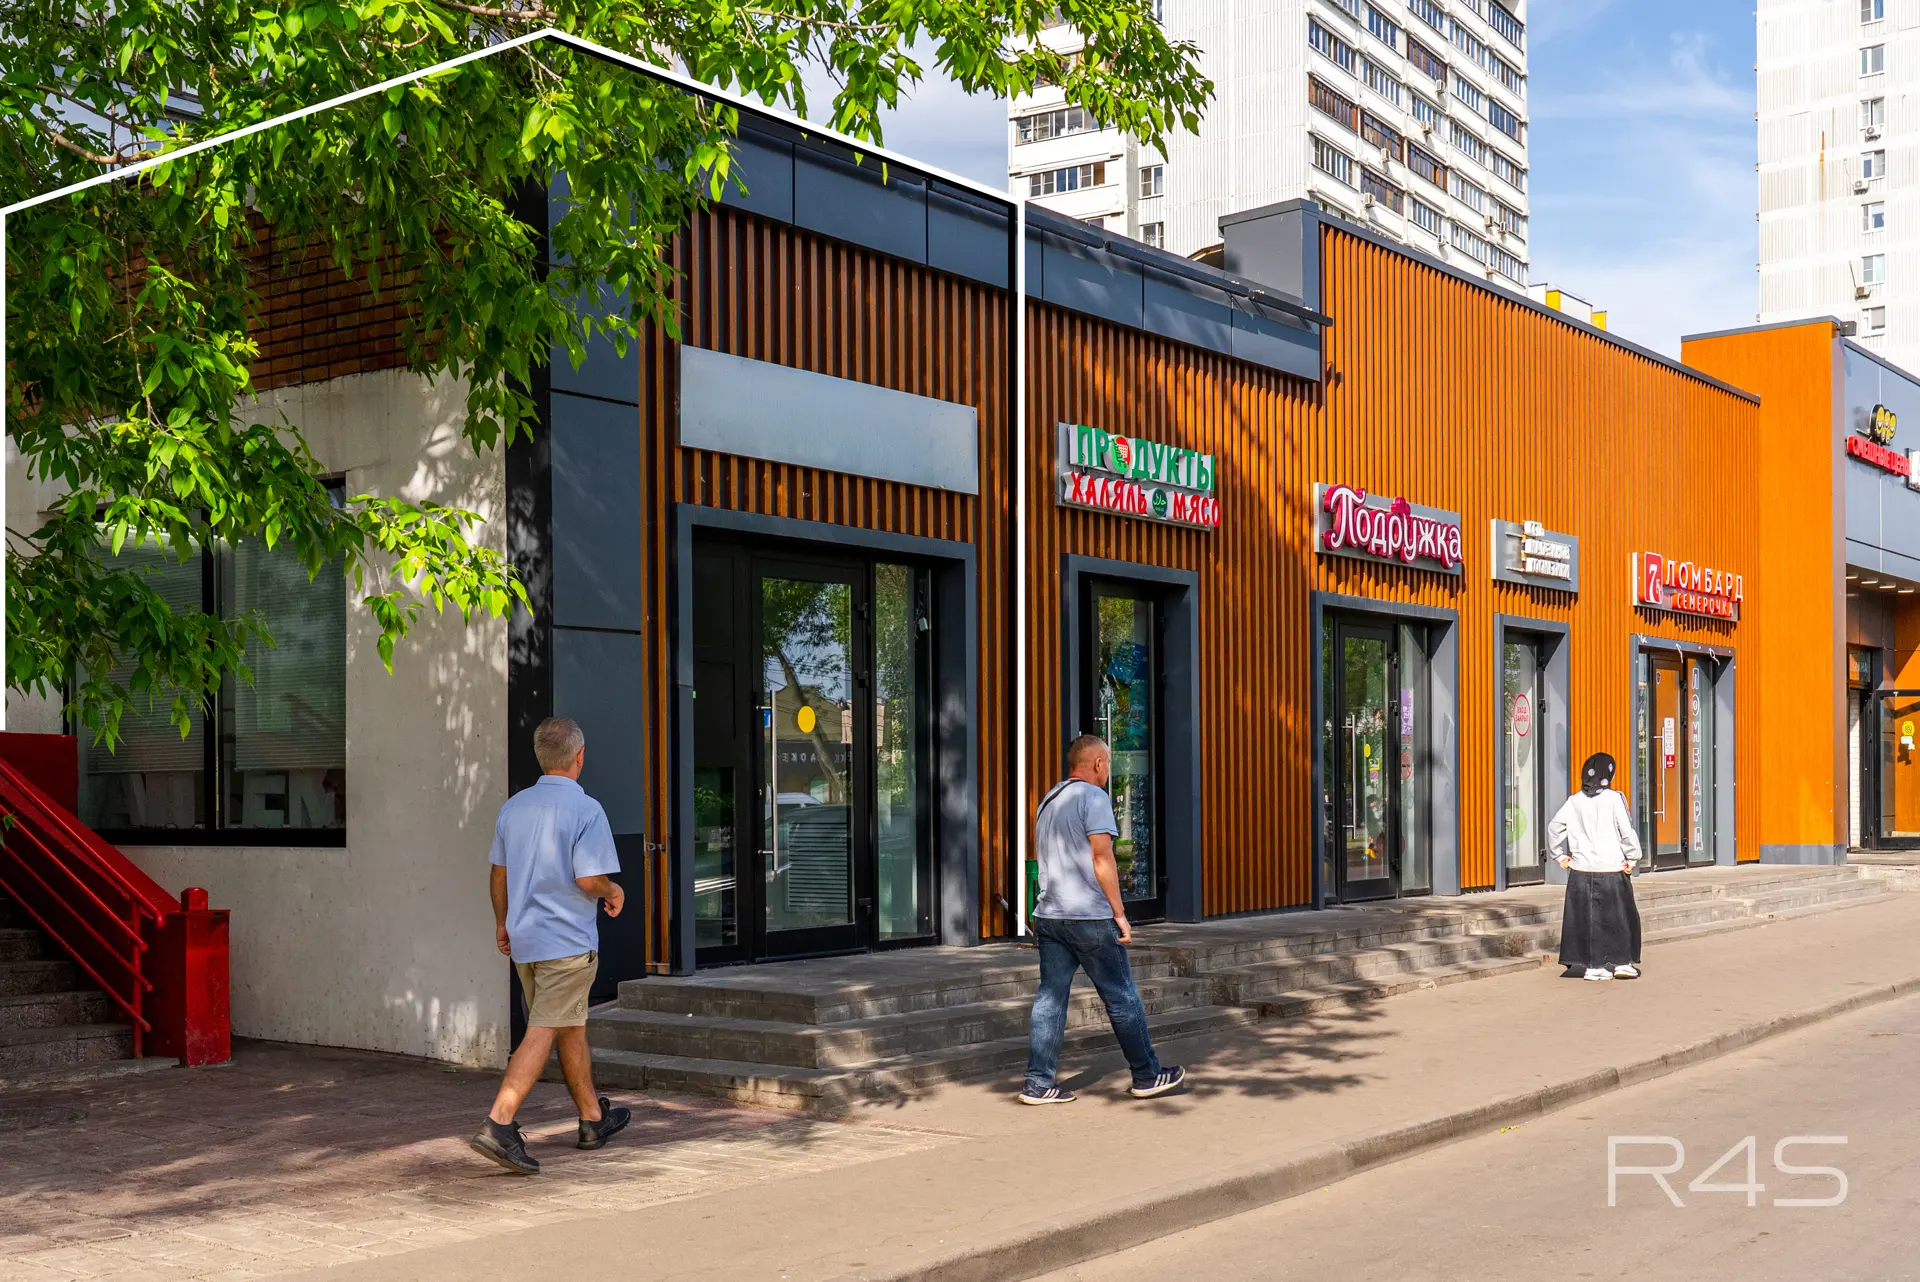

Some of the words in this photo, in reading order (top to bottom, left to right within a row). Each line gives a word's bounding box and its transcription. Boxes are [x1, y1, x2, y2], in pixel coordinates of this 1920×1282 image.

[1067, 471, 1147, 514] ХАЛЯЛЬ
[1173, 490, 1221, 527] МЯСО
[1326, 485, 1463, 568] Подружка
[1665, 559, 1744, 603] ЛОМБАРД
[1676, 592, 1734, 617] СЕМЕРОЧКА
[1691, 667, 1704, 851] ЛОМБАРД
